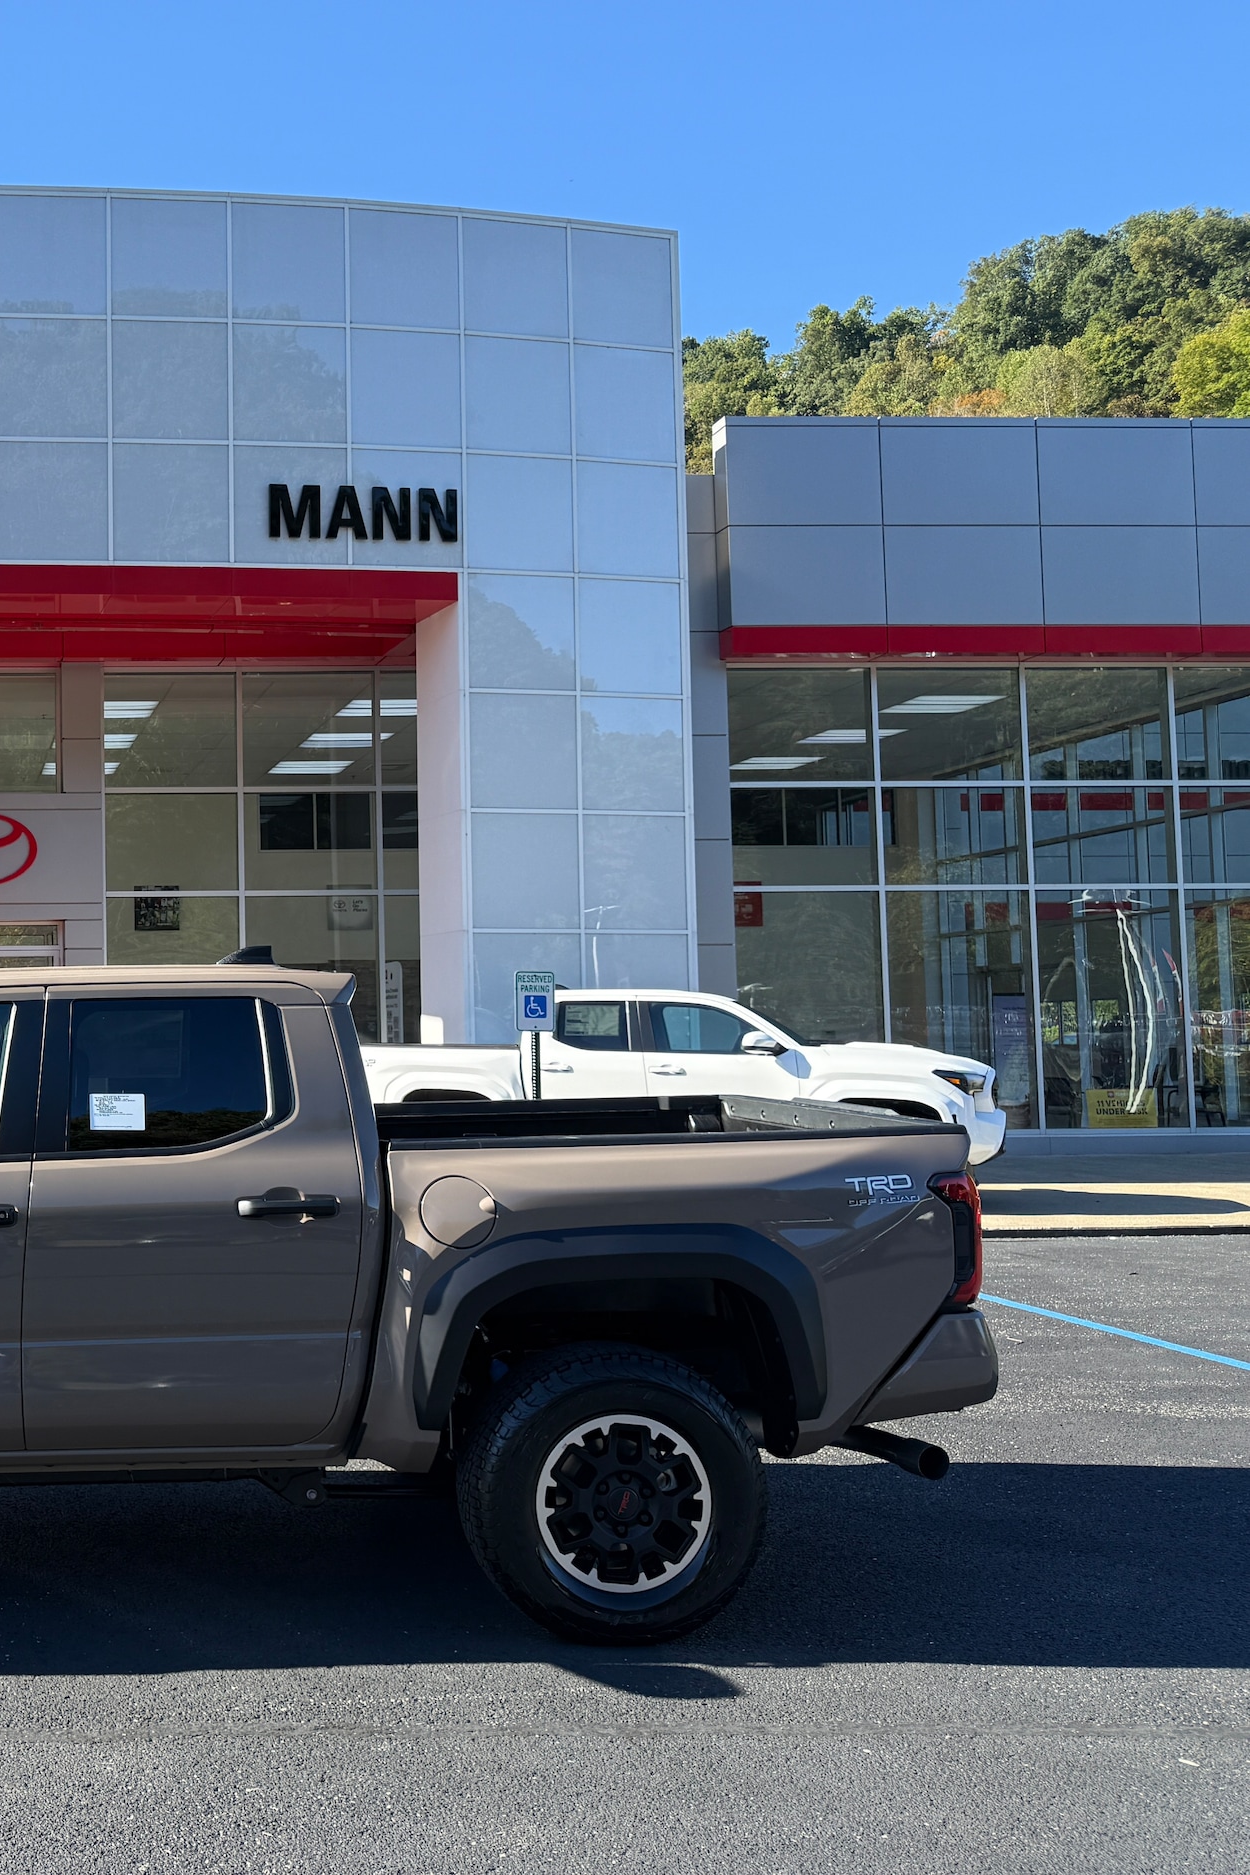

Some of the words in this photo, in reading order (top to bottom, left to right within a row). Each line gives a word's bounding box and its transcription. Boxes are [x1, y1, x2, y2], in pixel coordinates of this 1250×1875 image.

[269, 484, 457, 542] MANN
[517, 975, 552, 983] RESERVED
[520, 985, 550, 993] PARKING
[845, 1174, 912, 1195] TRD
